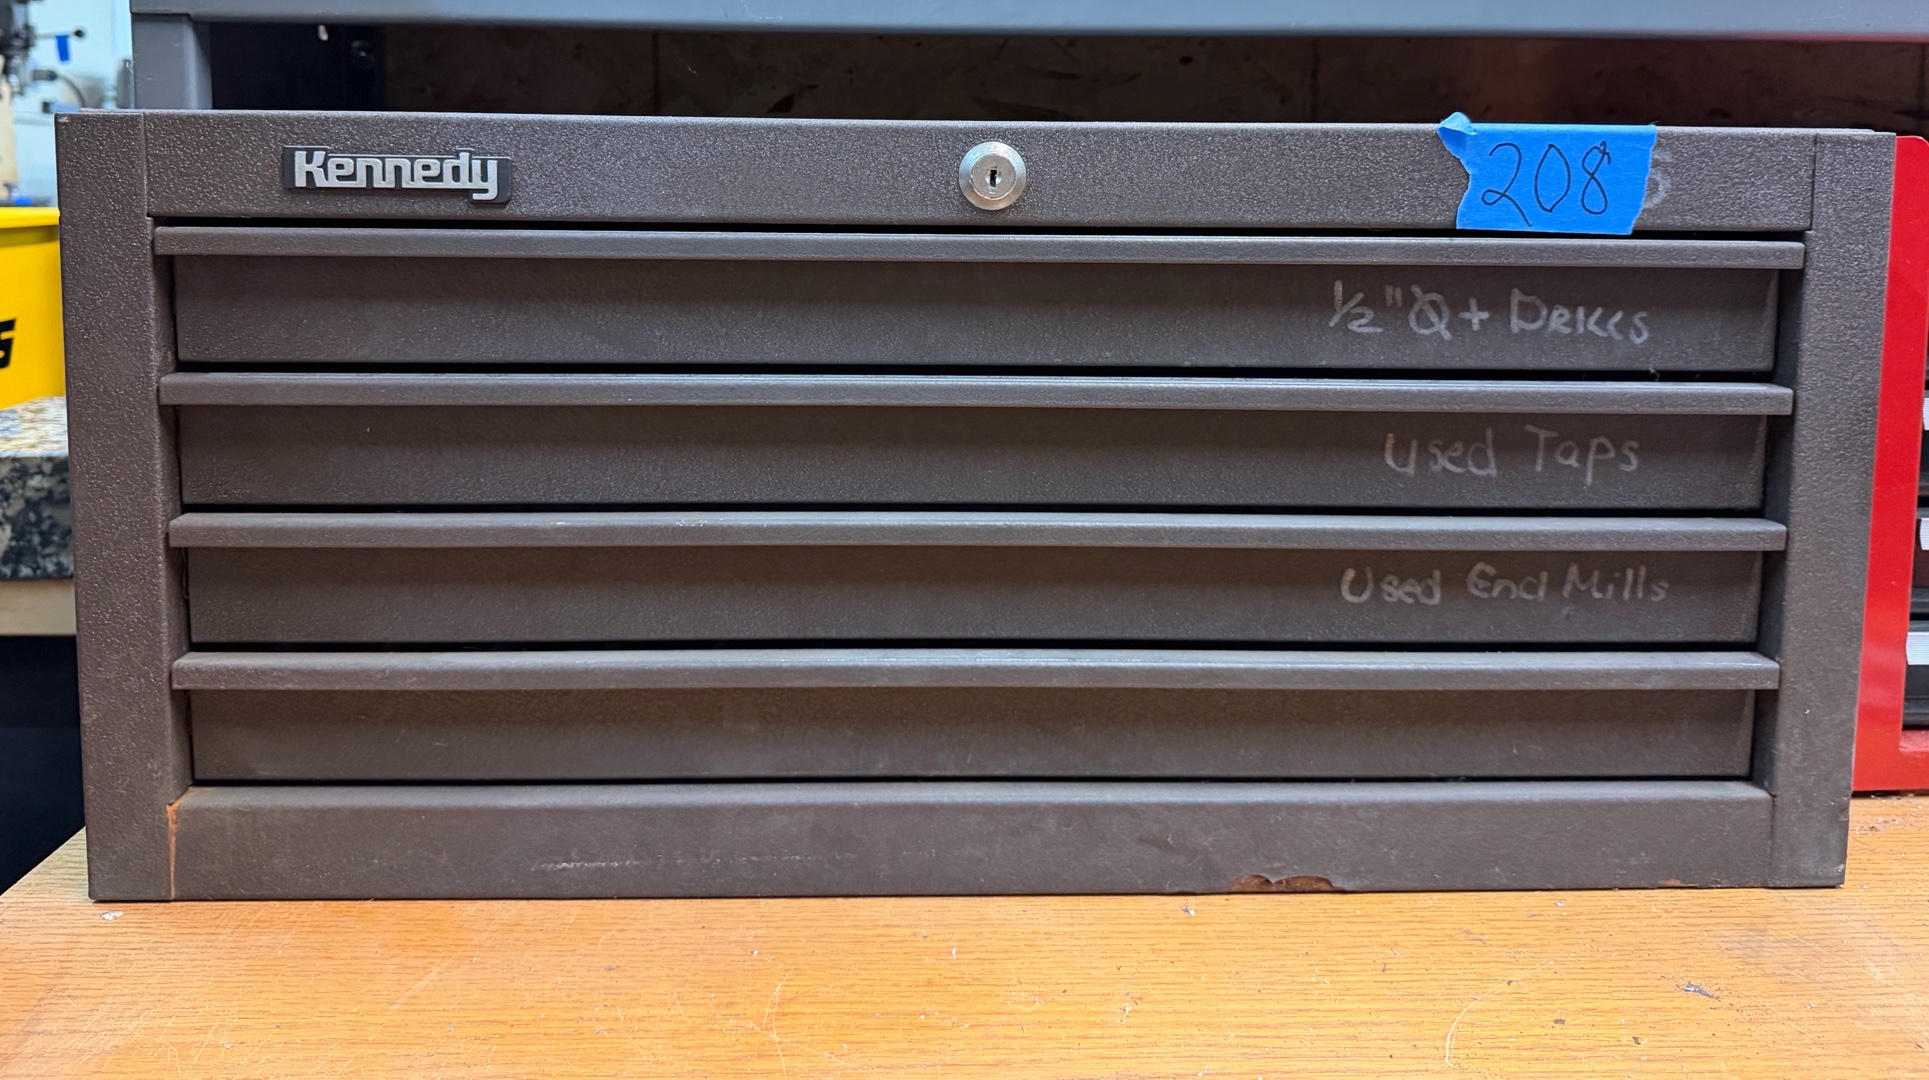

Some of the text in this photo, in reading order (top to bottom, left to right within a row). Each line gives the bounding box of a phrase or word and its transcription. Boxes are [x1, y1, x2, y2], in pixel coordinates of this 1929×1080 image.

[294, 150, 498, 201] Kennedy
[1480, 140, 1612, 228] 208
[1524, 424, 1640, 486] Taps
[1340, 561, 1670, 604] Used End Mills
